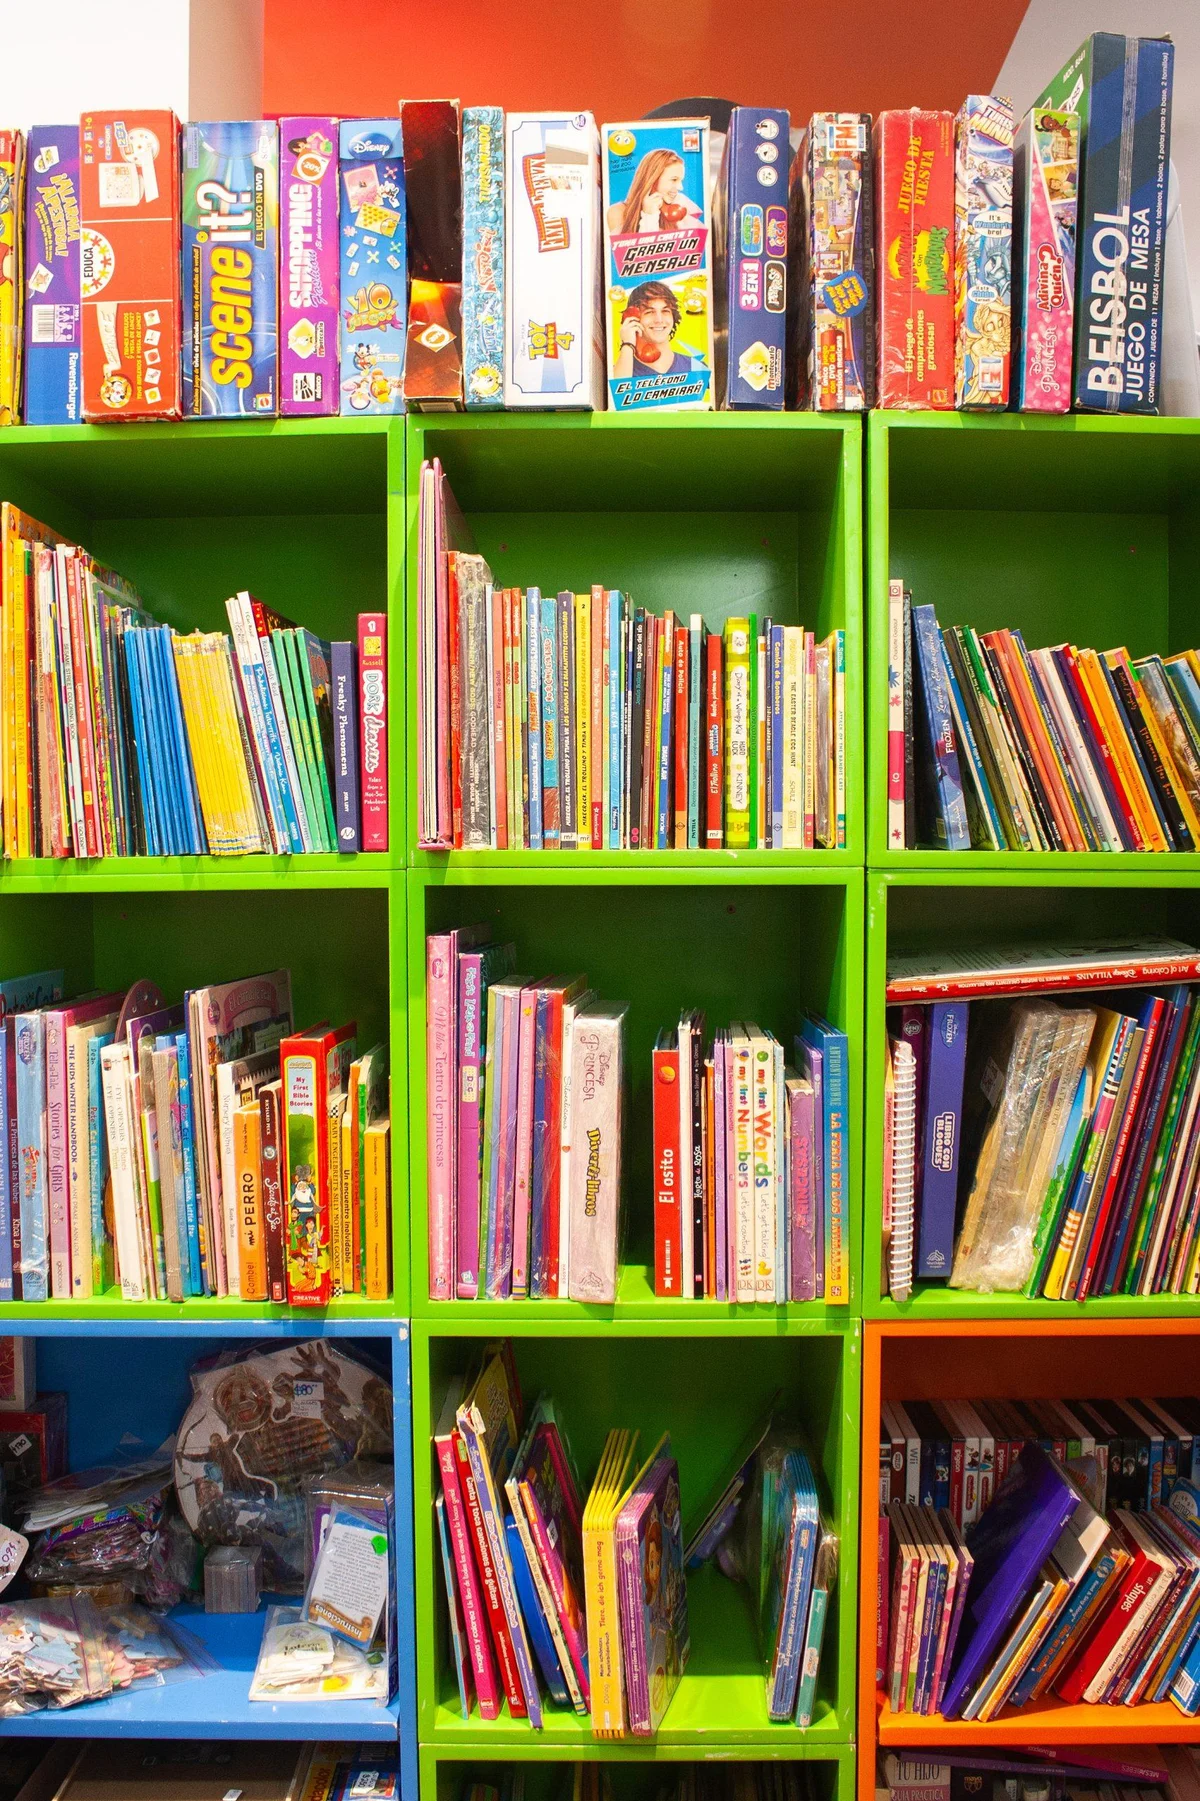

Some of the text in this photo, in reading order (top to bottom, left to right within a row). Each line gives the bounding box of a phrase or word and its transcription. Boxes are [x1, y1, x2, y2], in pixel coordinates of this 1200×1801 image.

[478, 124, 491, 203] TURISMUNDO
[898, 136, 923, 214] JUEGO DE
[912, 148, 935, 205] FIESTA
[36, 186, 69, 257] APESTOSA!
[256, 206, 264, 231] JUEGO
[256, 231, 263, 241] EL
[83, 247, 94, 279] EDUCA
[288, 184, 313, 309] SHOPPING
[623, 237, 700, 262] GRABA UN
[924, 225, 949, 295] MANZANAS
[304, 249, 328, 309] Fashion
[620, 254, 702, 277] MENSAJE
[195, 180, 254, 389] scene it?
[1037, 262, 1050, 311] Adivina
[1087, 206, 1130, 395] BEISBOL
[1151, 284, 1159, 305] PIEZAS
[1125, 207, 1150, 401] JUEGO DE MESA
[528, 319, 547, 361] TOY
[905, 333, 915, 361] juego
[916, 310, 925, 382] comparaciones
[926, 322, 937, 370] graciosas!
[1040, 325, 1060, 393] PRINCESA
[68, 352, 80, 421] Ravensburger
[616, 374, 688, 393] EL TELÉFONO
[622, 380, 704, 406] LO CAMBIARÁ
[15, 591, 23, 611] dodd
[16, 645, 24, 691] BROTHERS
[467, 604, 477, 748] GREEN GODHEAD
[947, 665, 956, 680] Becky
[66, 689, 75, 723] COLORING
[734, 672, 743, 723] Diary Wimpy
[336, 675, 349, 776] Freaky Phenomena
[365, 672, 383, 772] DORK diaries
[941, 719, 954, 753] FROZEN
[17, 745, 25, 765] NAPS
[1140, 726, 1157, 762] Halloween
[735, 773, 743, 805] KINNEY
[1076, 970, 1111, 981] VILLAINS
[1142, 964, 1188, 976] Art Coloring
[68, 1044, 76, 1059] THE
[580, 1034, 599, 1102] PRINCESA
[597, 1051, 612, 1087] Disney
[292, 1084, 309, 1092] First
[295, 1076, 305, 1084] My
[828, 1045, 841, 1107] ANTHONY BROWNE
[290, 1100, 314, 1108] Stories
[292, 1092, 309, 1100] Bible
[433, 1052, 447, 1167] Teatro de princesas
[562, 1076, 572, 1129] Silverlicious
[49, 1049, 64, 1192] Tell-a-Tale Stories for GIRLS
[70, 1115, 78, 1163] HANDBOOK
[737, 1066, 751, 1188] my first Numbers
[755, 1069, 772, 1188] my first Words
[1110, 1094, 1137, 1176] MICKEY FRIENDS
[11, 1126, 19, 1158] Princesa
[934, 1117, 944, 1165] BLOQUES
[941, 1114, 953, 1169] LIBRO CON
[344, 1169, 350, 1179] Un
[584, 1128, 602, 1217] Diverti-libros
[659, 1149, 674, 1204] El osito
[795, 1135, 809, 1229] PRINCESAS
[242, 1173, 256, 1226] PERRO
[264, 1178, 278, 1207] Secrets
[830, 1112, 841, 1281] LA DE LOS ANIMALES
[344, 1221, 352, 1264] inolvidable
[739, 1223, 749, 1256] counting!
[759, 1228, 770, 1259] talking!
[246, 1261, 257, 1294] Combel
[738, 1280, 754, 1291] DK
[756, 1280, 773, 1291] DK
[441, 1451, 454, 1474] Barbie
[909, 1447, 918, 1464] Wii
[954, 1449, 962, 1472] pigeon
[997, 1449, 1005, 1472] pigeon
[463, 1477, 500, 1609] Canta toca canciones guitarra
[595, 1541, 603, 1557] mag
[596, 1558, 605, 1579] gerne
[625, 1570, 635, 1618] rompecabezas
[1117, 1580, 1147, 1615] shapes
[314, 1602, 365, 1639] Instrucciones
[474, 1644, 486, 1673] Imagina
[1107, 1627, 1139, 1672] Language Nursery
[896, 1763, 940, 1783] TU HIJO
